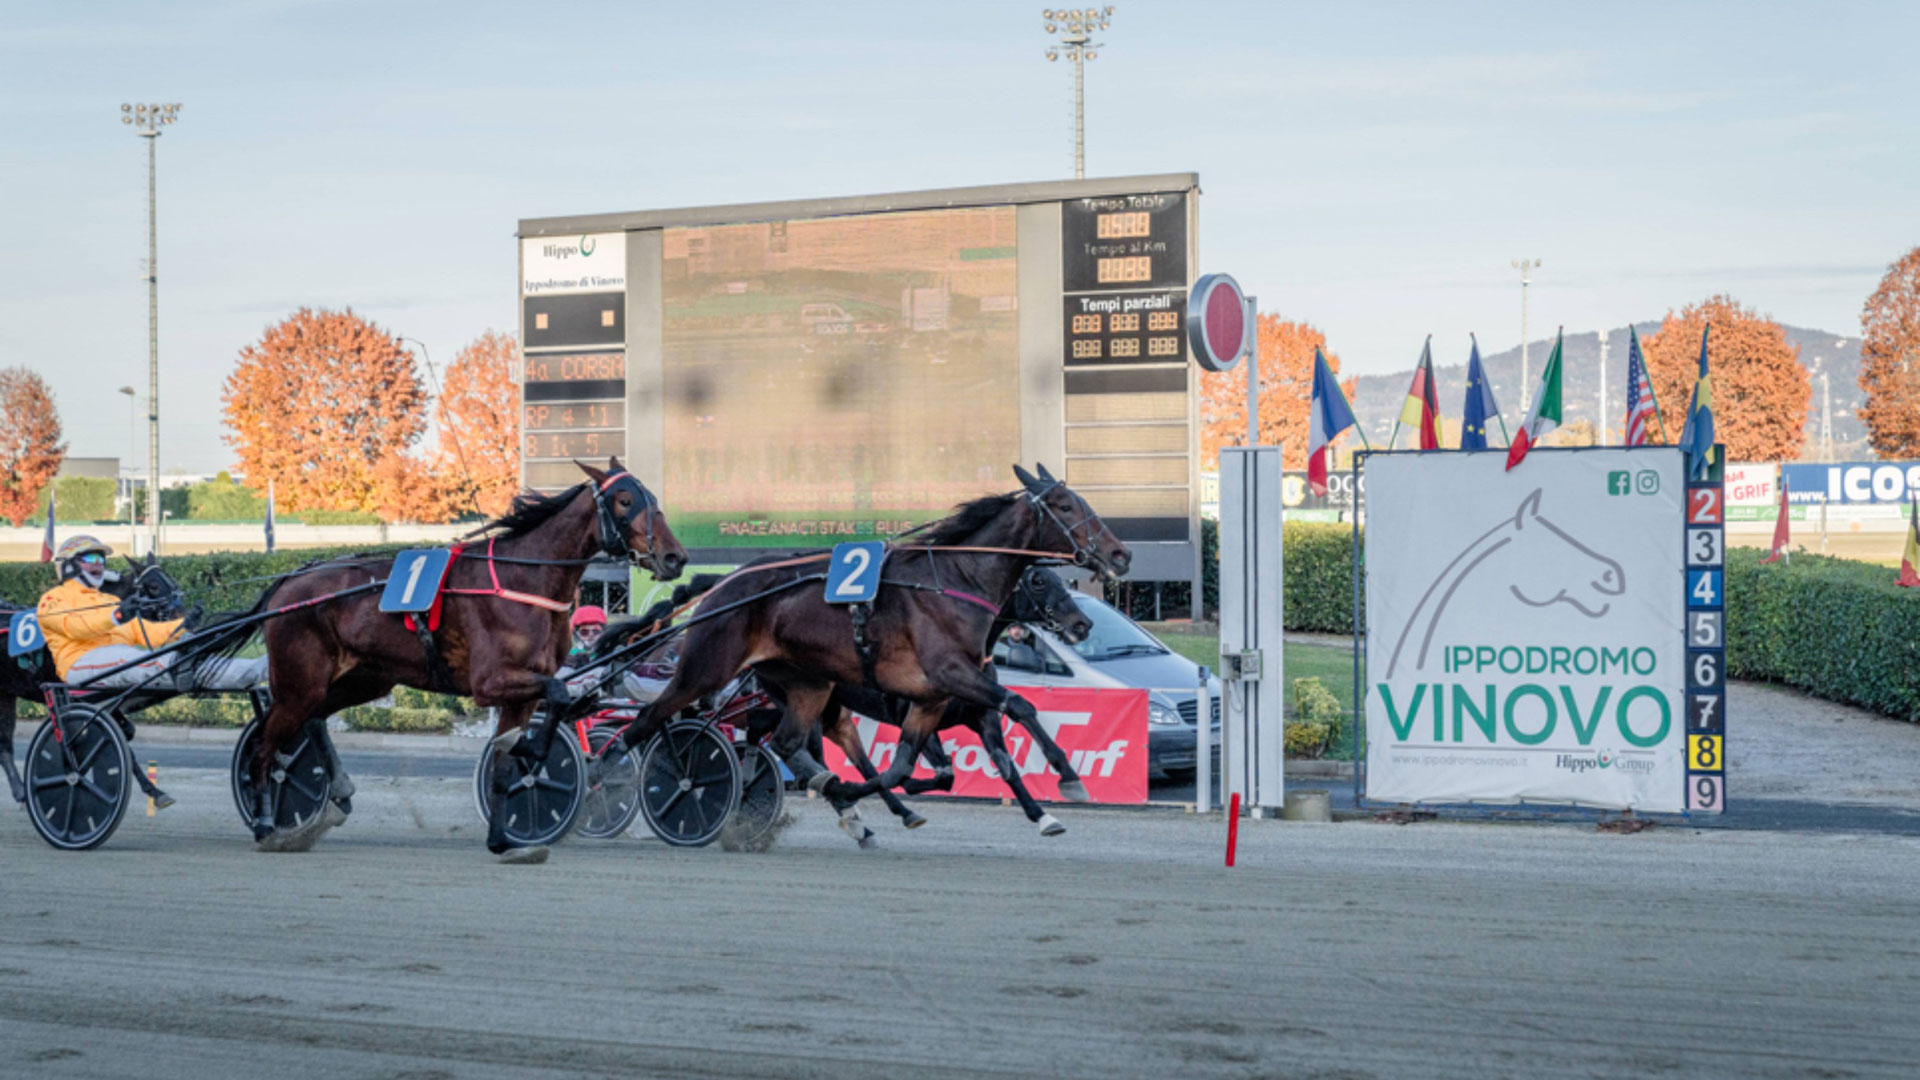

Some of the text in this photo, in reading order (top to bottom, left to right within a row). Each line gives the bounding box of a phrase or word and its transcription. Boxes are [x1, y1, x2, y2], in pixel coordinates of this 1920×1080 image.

[1082, 198, 1126, 210] Tempo
[543, 243, 578, 259] Hippo
[1084, 243, 1126, 255] Tempo
[1144, 241, 1166, 251] Km
[525, 276, 624, 290] Ippodromo di Vinovo
[1081, 295, 1170, 313] Tempi parziali
[525, 404, 609, 428] RP 4 11
[525, 435, 538, 457] 8
[586, 433, 600, 455] 5
[1694, 488, 1717, 522] 2
[1733, 483, 1770, 501] GRIF
[1695, 531, 1716, 562] 3
[401, 554, 427, 604] 1
[836, 547, 870, 595] 2
[1693, 571, 1716, 604] 4
[16, 613, 37, 648] 6
[1694, 613, 1716, 646] 5
[1444, 645, 1656, 676] IPPODROMO
[1694, 654, 1716, 686] 6
[1377, 682, 1671, 747] VINOVO
[1695, 696, 1717, 727] 7
[1391, 754, 1529, 767] www.ippodromovinovo.it
[1555, 753, 1656, 775] Hippo Group
[1695, 736, 1716, 768] 8
[1696, 777, 1717, 810] 9
